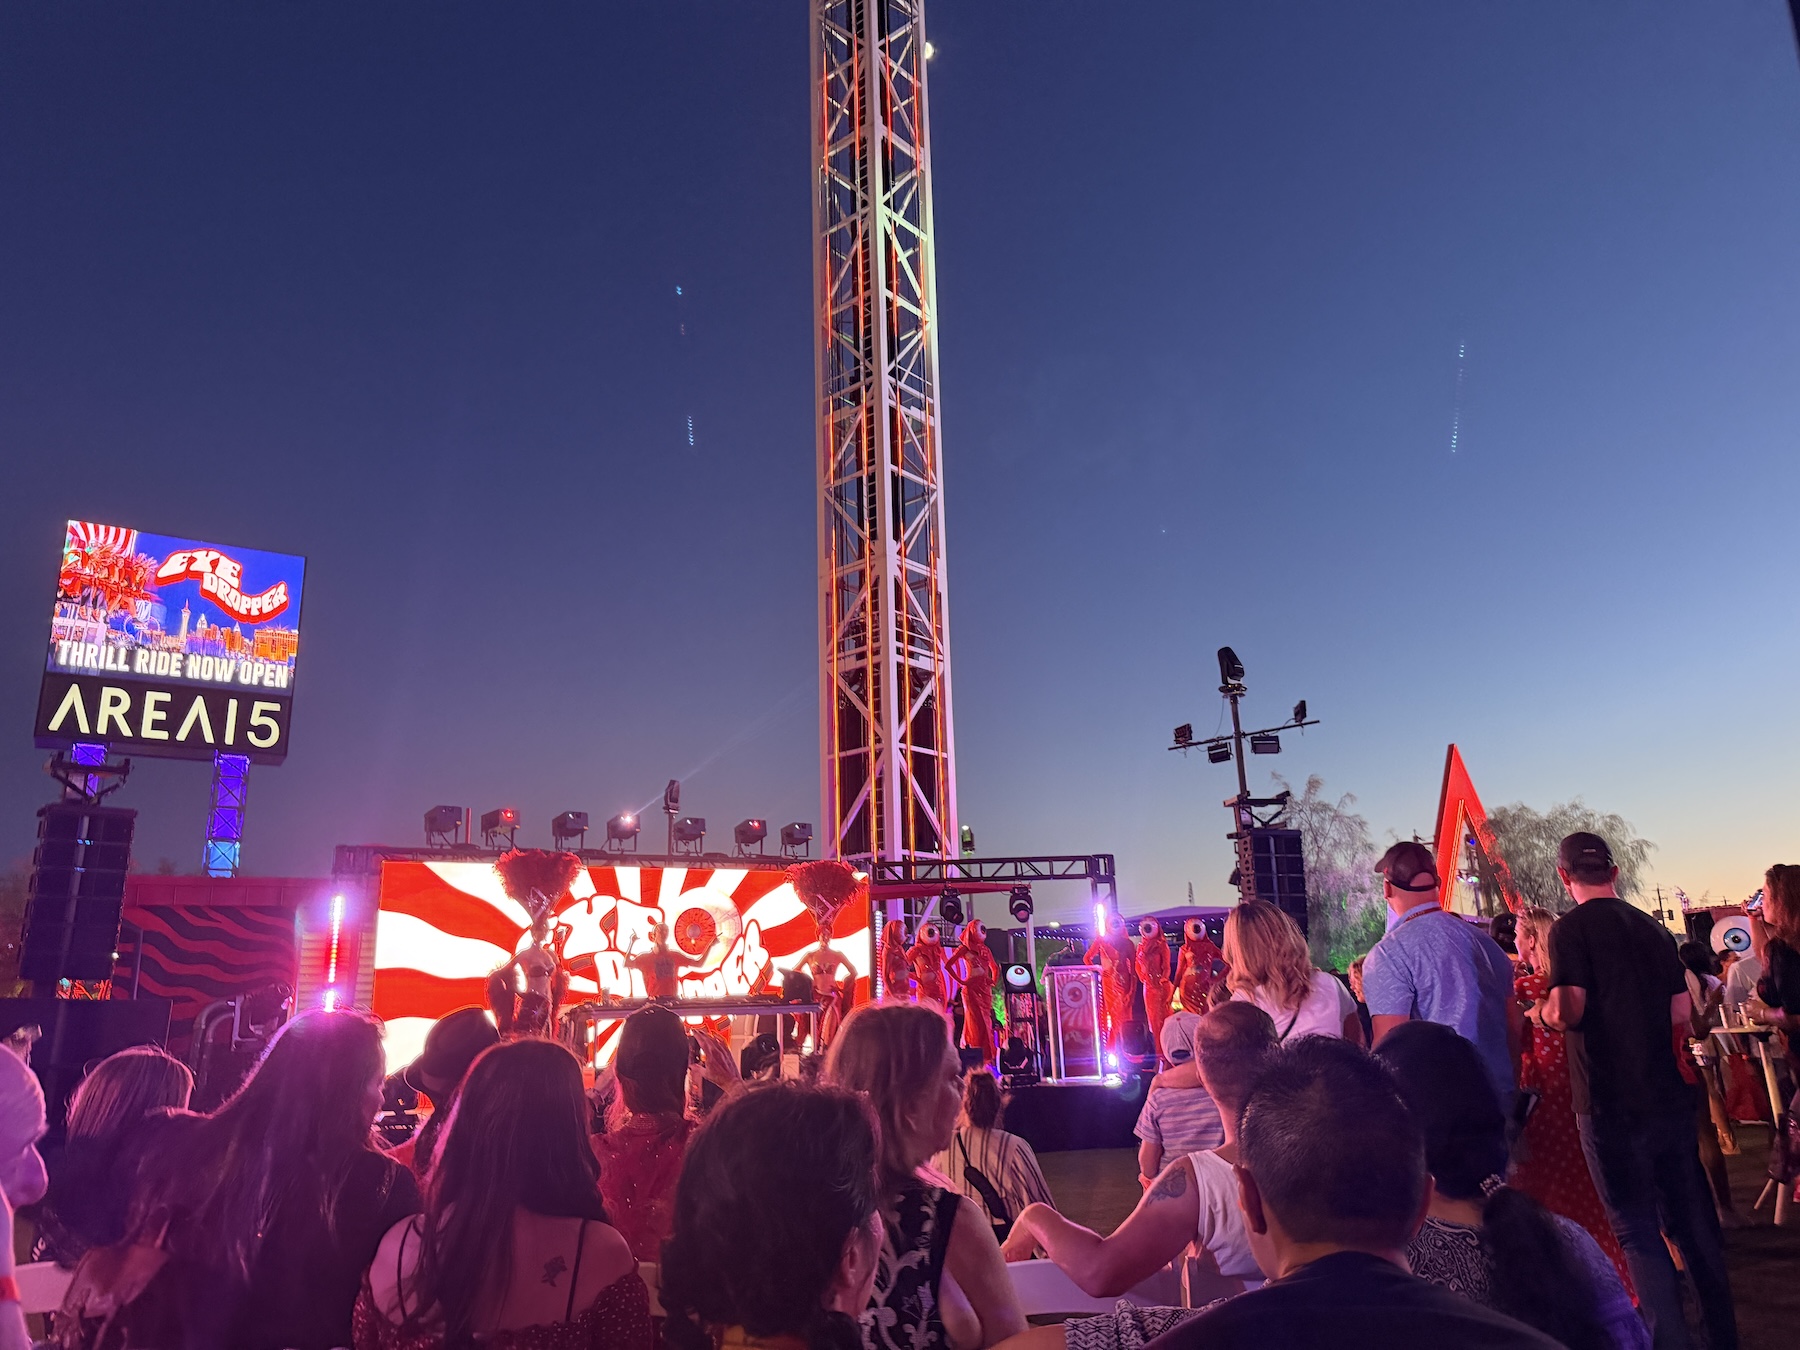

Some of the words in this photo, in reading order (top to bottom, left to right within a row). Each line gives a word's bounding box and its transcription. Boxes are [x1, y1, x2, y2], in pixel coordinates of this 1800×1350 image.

[157, 550, 240, 588] EYE
[202, 572, 288, 616] DROPPER
[58, 640, 129, 672] THRILL
[134, 648, 183, 678] RIDE
[187, 653, 235, 683] NOW
[239, 661, 289, 689] OPEN
[594, 919, 769, 998] DPPER
